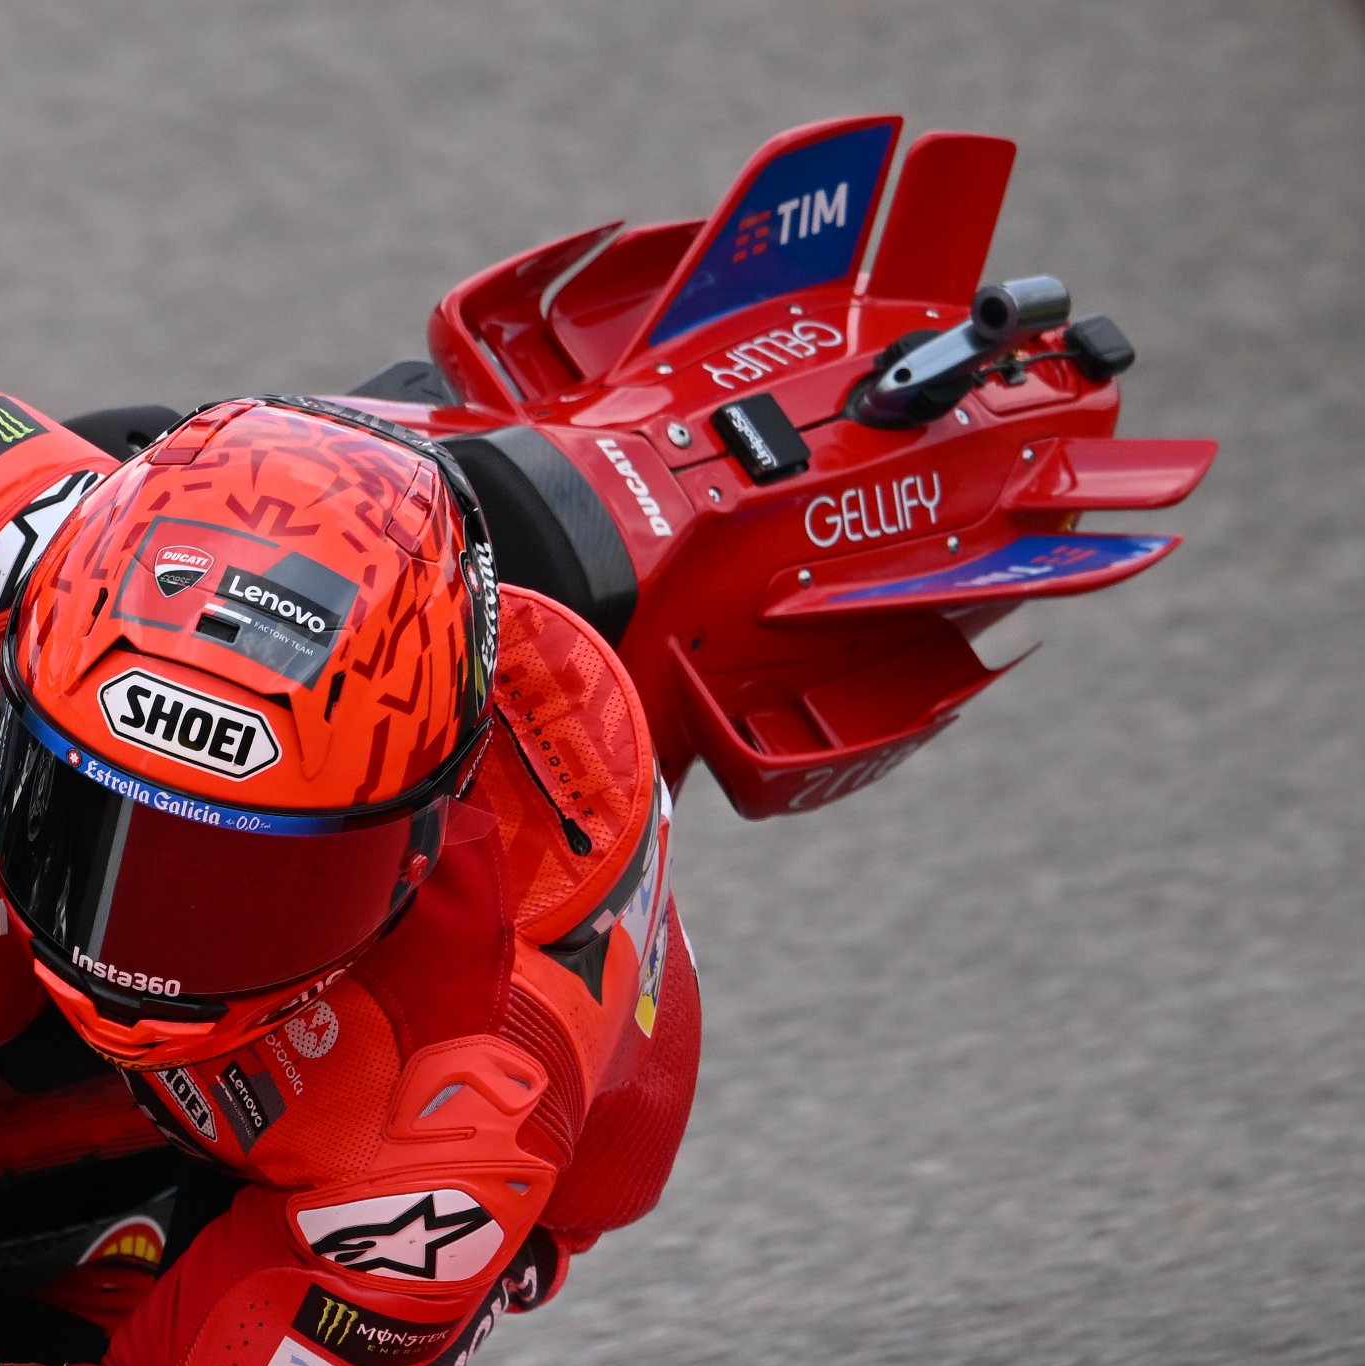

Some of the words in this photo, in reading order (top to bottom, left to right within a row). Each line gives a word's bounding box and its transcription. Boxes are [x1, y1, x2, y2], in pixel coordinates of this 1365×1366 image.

[776, 183, 848, 246] TIM
[704, 321, 845, 389] GELLIFY
[594, 438, 672, 538] DUCATI
[804, 472, 941, 549] GELLIFY
[162, 551, 209, 567] DUCATI
[228, 575, 326, 633] Lenovo
[253, 620, 290, 644] FACTORY
[290, 638, 314, 656] TEAM
[118, 684, 257, 767] SHOEI
[84, 760, 150, 806] Estrella
[154, 792, 221, 826] Galicia
[72, 946, 181, 998] Insta360
[264, 1033, 305, 1097] otorola
[228, 1068, 263, 1128] Lenovo
